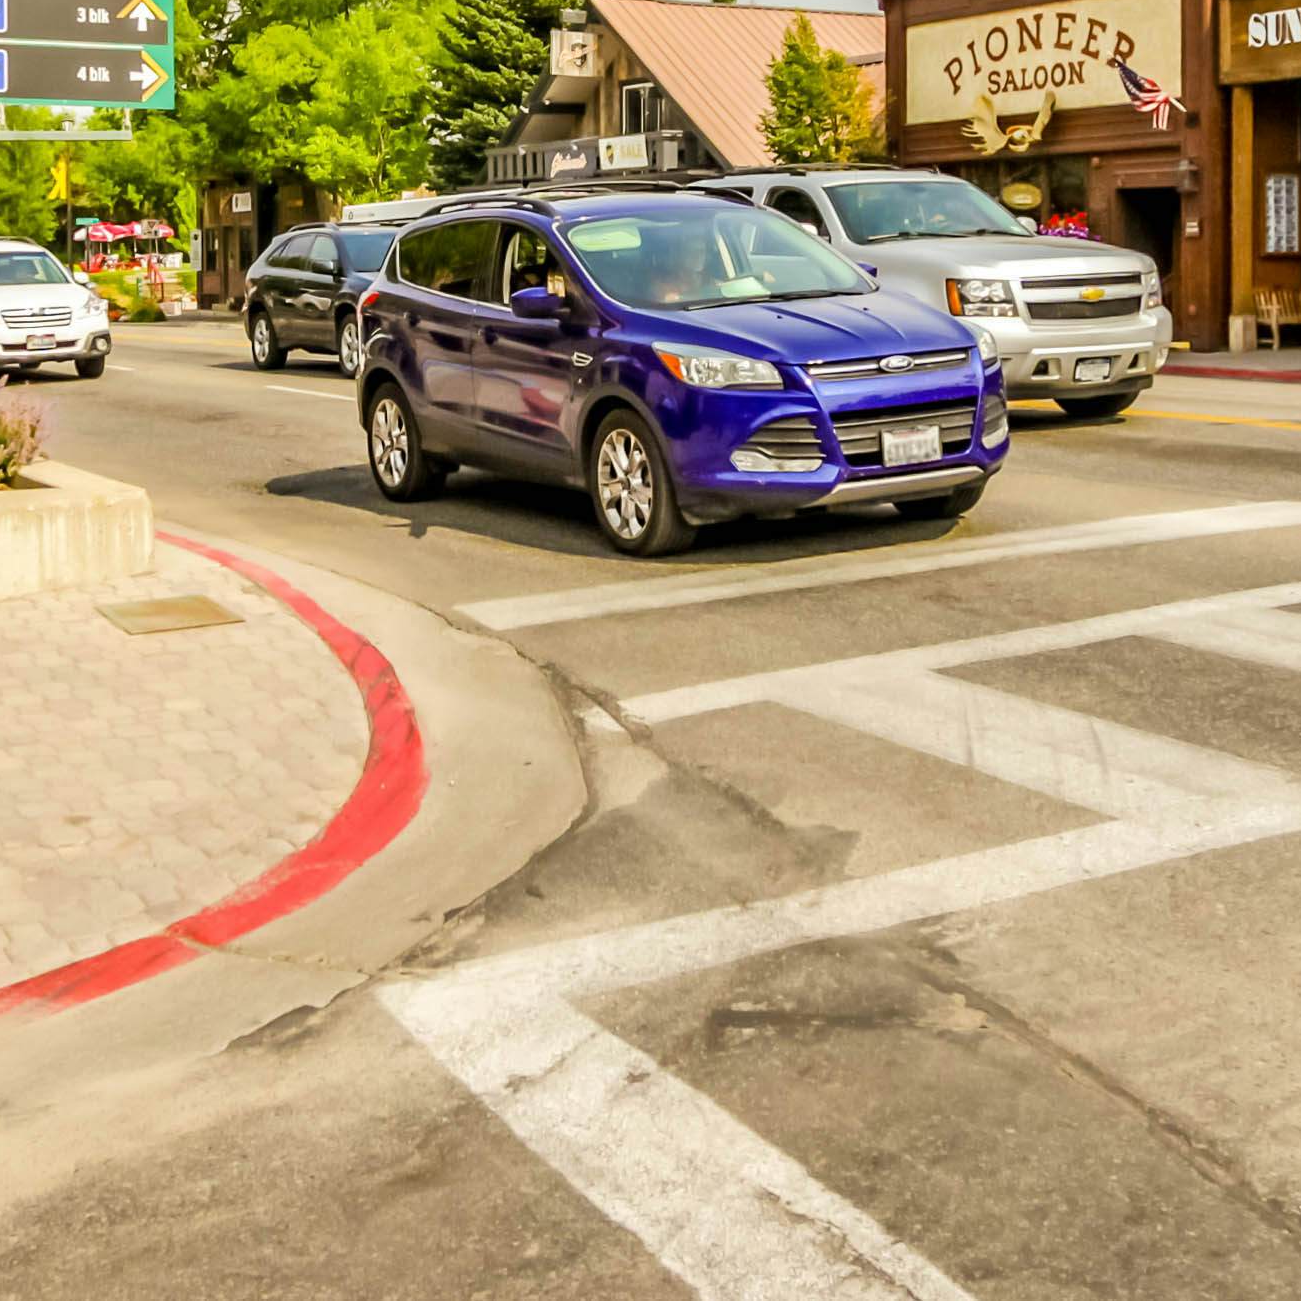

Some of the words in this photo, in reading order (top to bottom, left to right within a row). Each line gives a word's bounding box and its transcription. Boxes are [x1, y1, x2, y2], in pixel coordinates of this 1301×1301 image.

[76, 7, 86, 23] 3
[88, 8, 110, 24] blk
[76, 67, 87, 82] 4
[89, 67, 110, 82] blk
[987, 60, 1086, 96] SALOON
